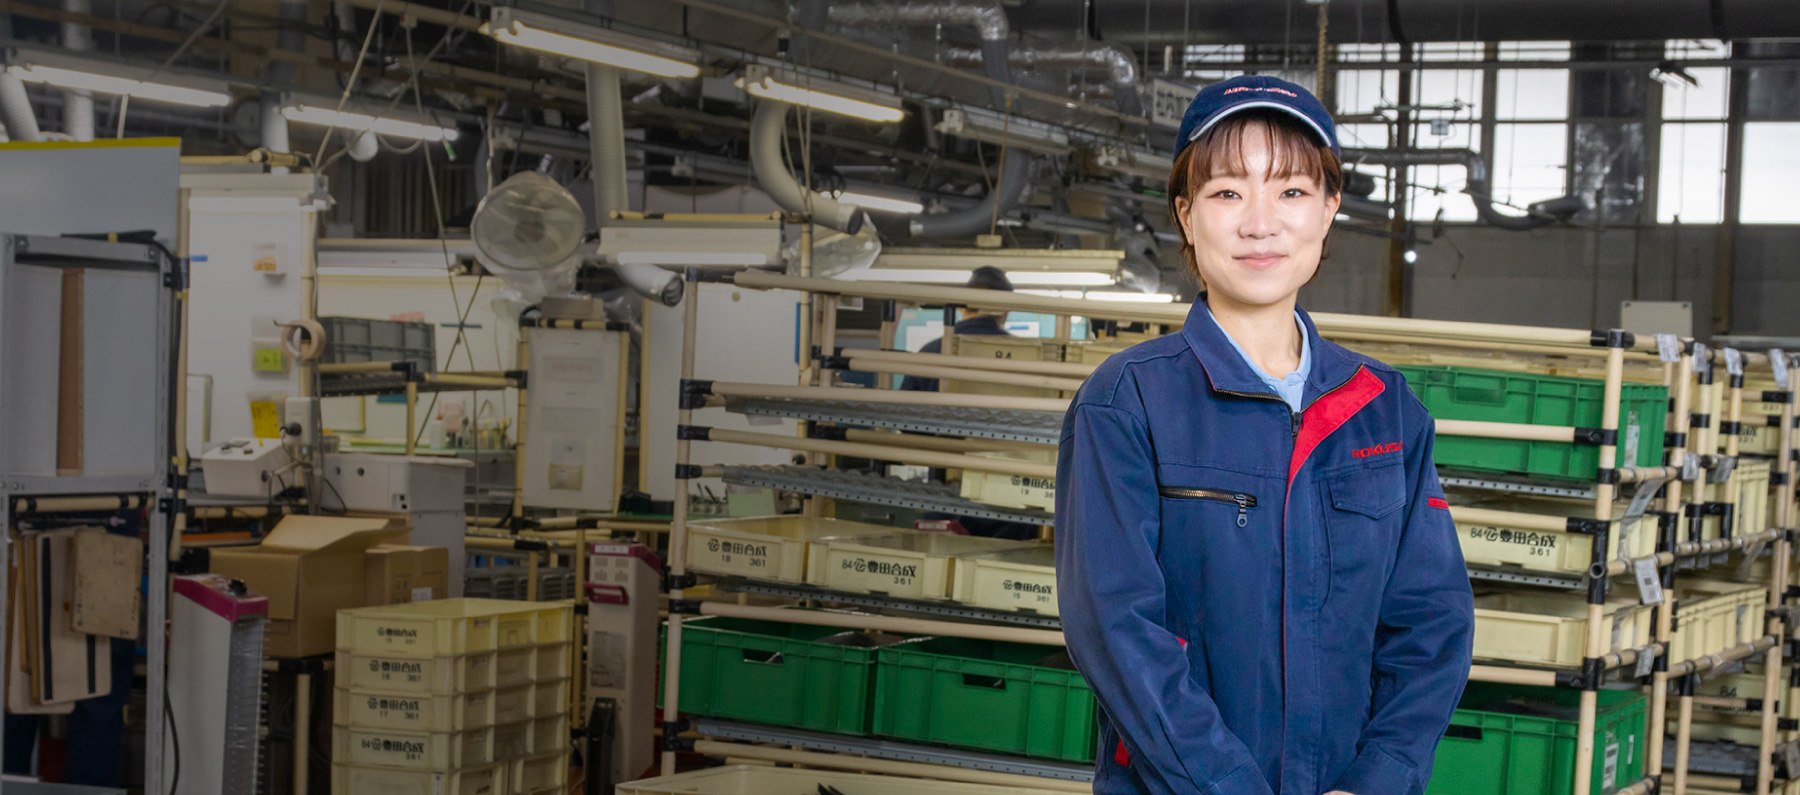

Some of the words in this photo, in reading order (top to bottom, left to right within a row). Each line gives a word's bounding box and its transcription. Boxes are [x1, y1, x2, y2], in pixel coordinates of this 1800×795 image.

[1470, 527, 1482, 538] 84
[1530, 547, 1551, 556] 361
[749, 558, 766, 568] 361
[842, 559, 853, 569] 84
[893, 577, 911, 585] 361
[1036, 595, 1050, 603] 361
